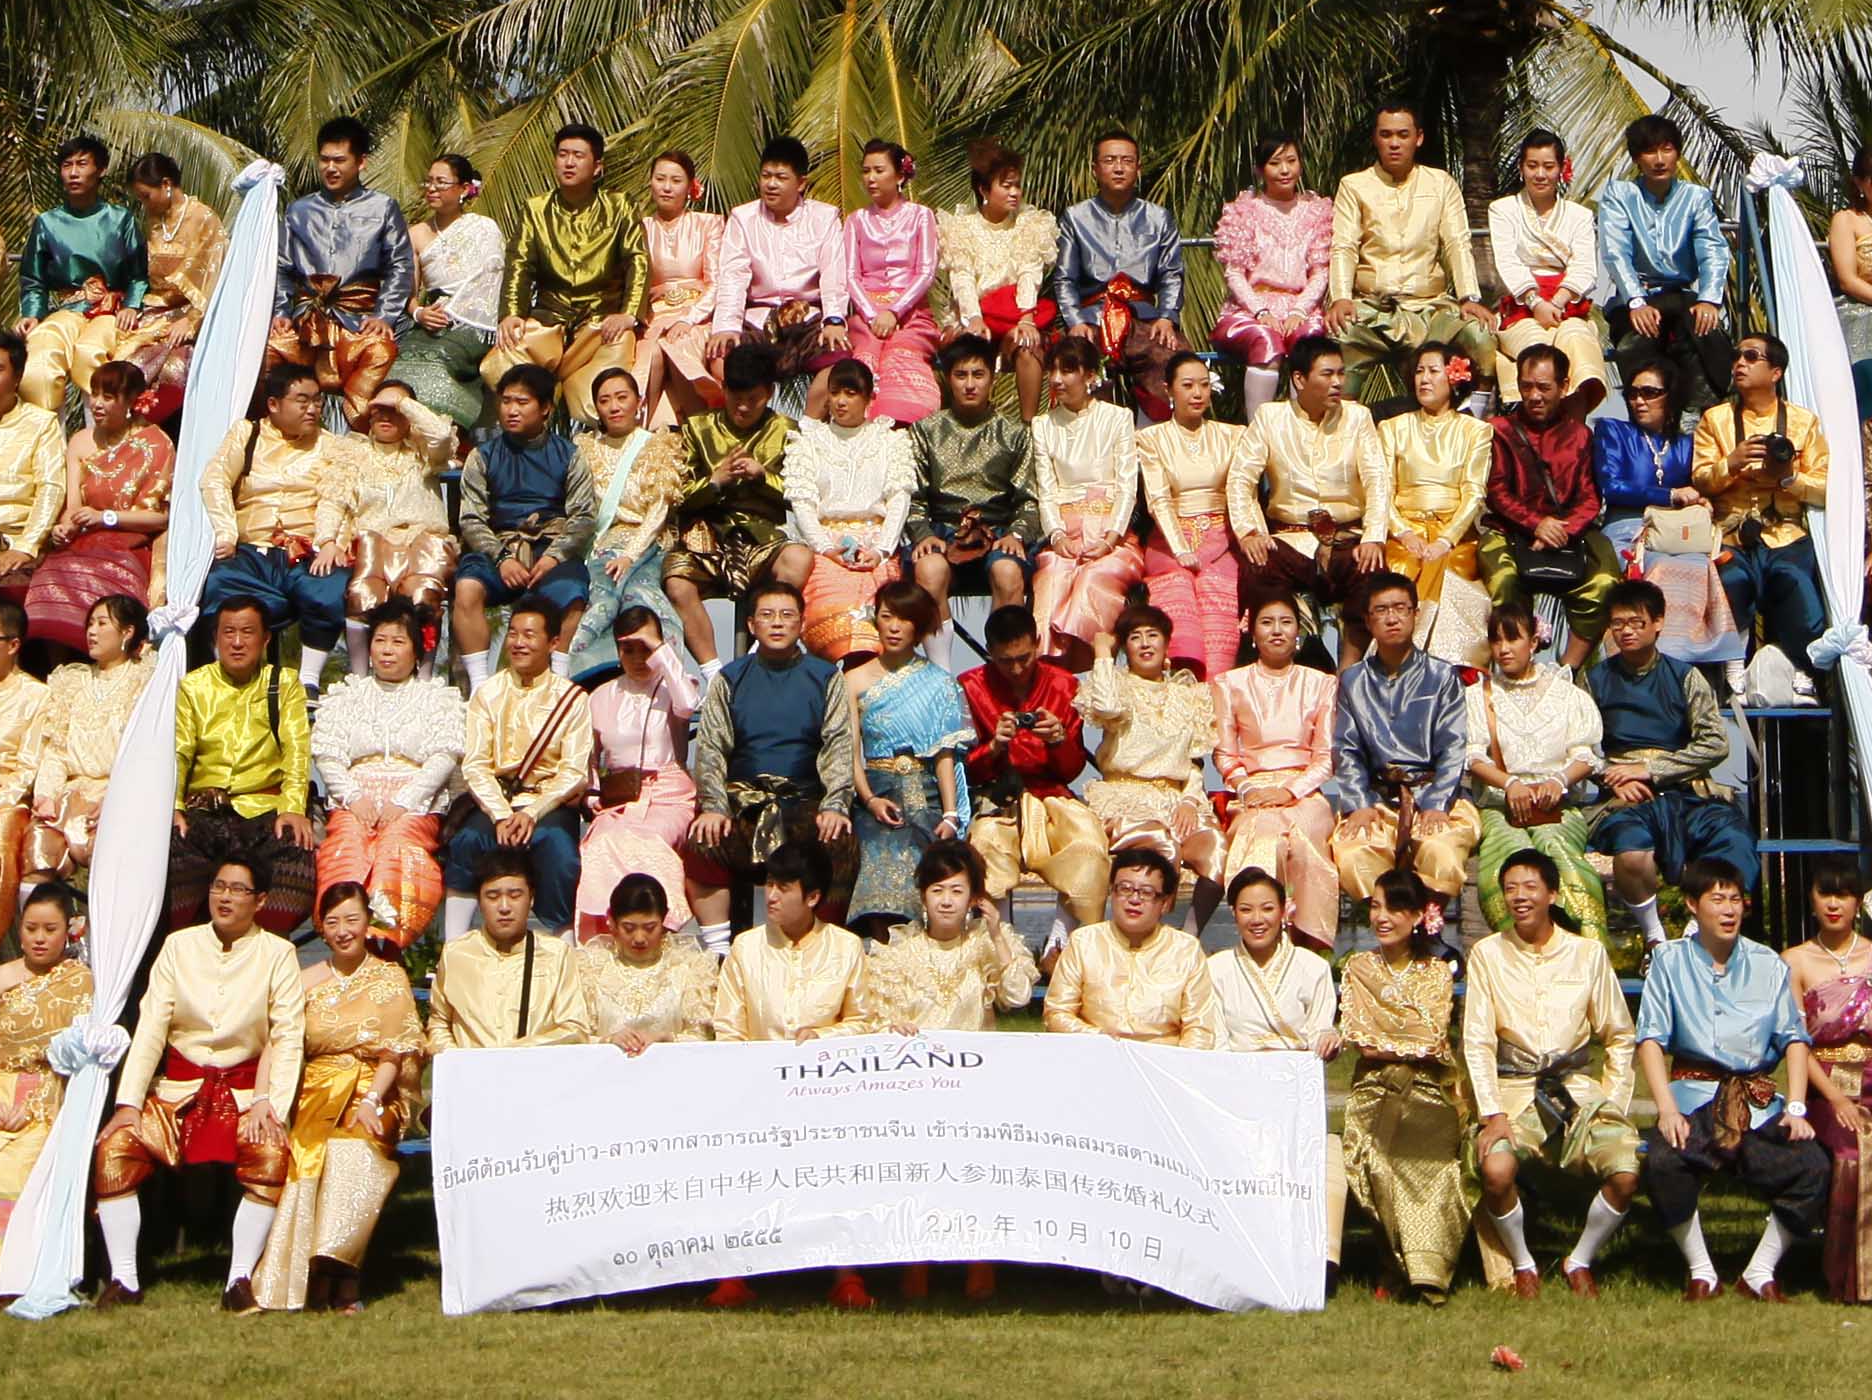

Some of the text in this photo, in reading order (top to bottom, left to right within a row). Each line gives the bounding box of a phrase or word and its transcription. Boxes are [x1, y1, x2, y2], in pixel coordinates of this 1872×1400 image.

[774, 1051, 984, 1080] THAILAND
[818, 1034, 946, 1062] amazing
[788, 1075, 962, 1098] Always Amazes You
[926, 1119, 1312, 1200] เข้าร่วมพิธีมงคลสมรสตามแบประเพณีไทย
[544, 1161, 1220, 1232] 热烈欢迎来自中华人民共和国新人参加泰国传统婚礼仪式
[647, 1235, 714, 1268] ตุลาคม
[724, 1227, 783, 1249] ๒๕๕๕
[993, 1214, 1016, 1236] 年
[1034, 1219, 1058, 1237] 10
[1068, 1221, 1088, 1244] 月
[1109, 1230, 1132, 1250] 10
[1143, 1235, 1162, 1261] 日
